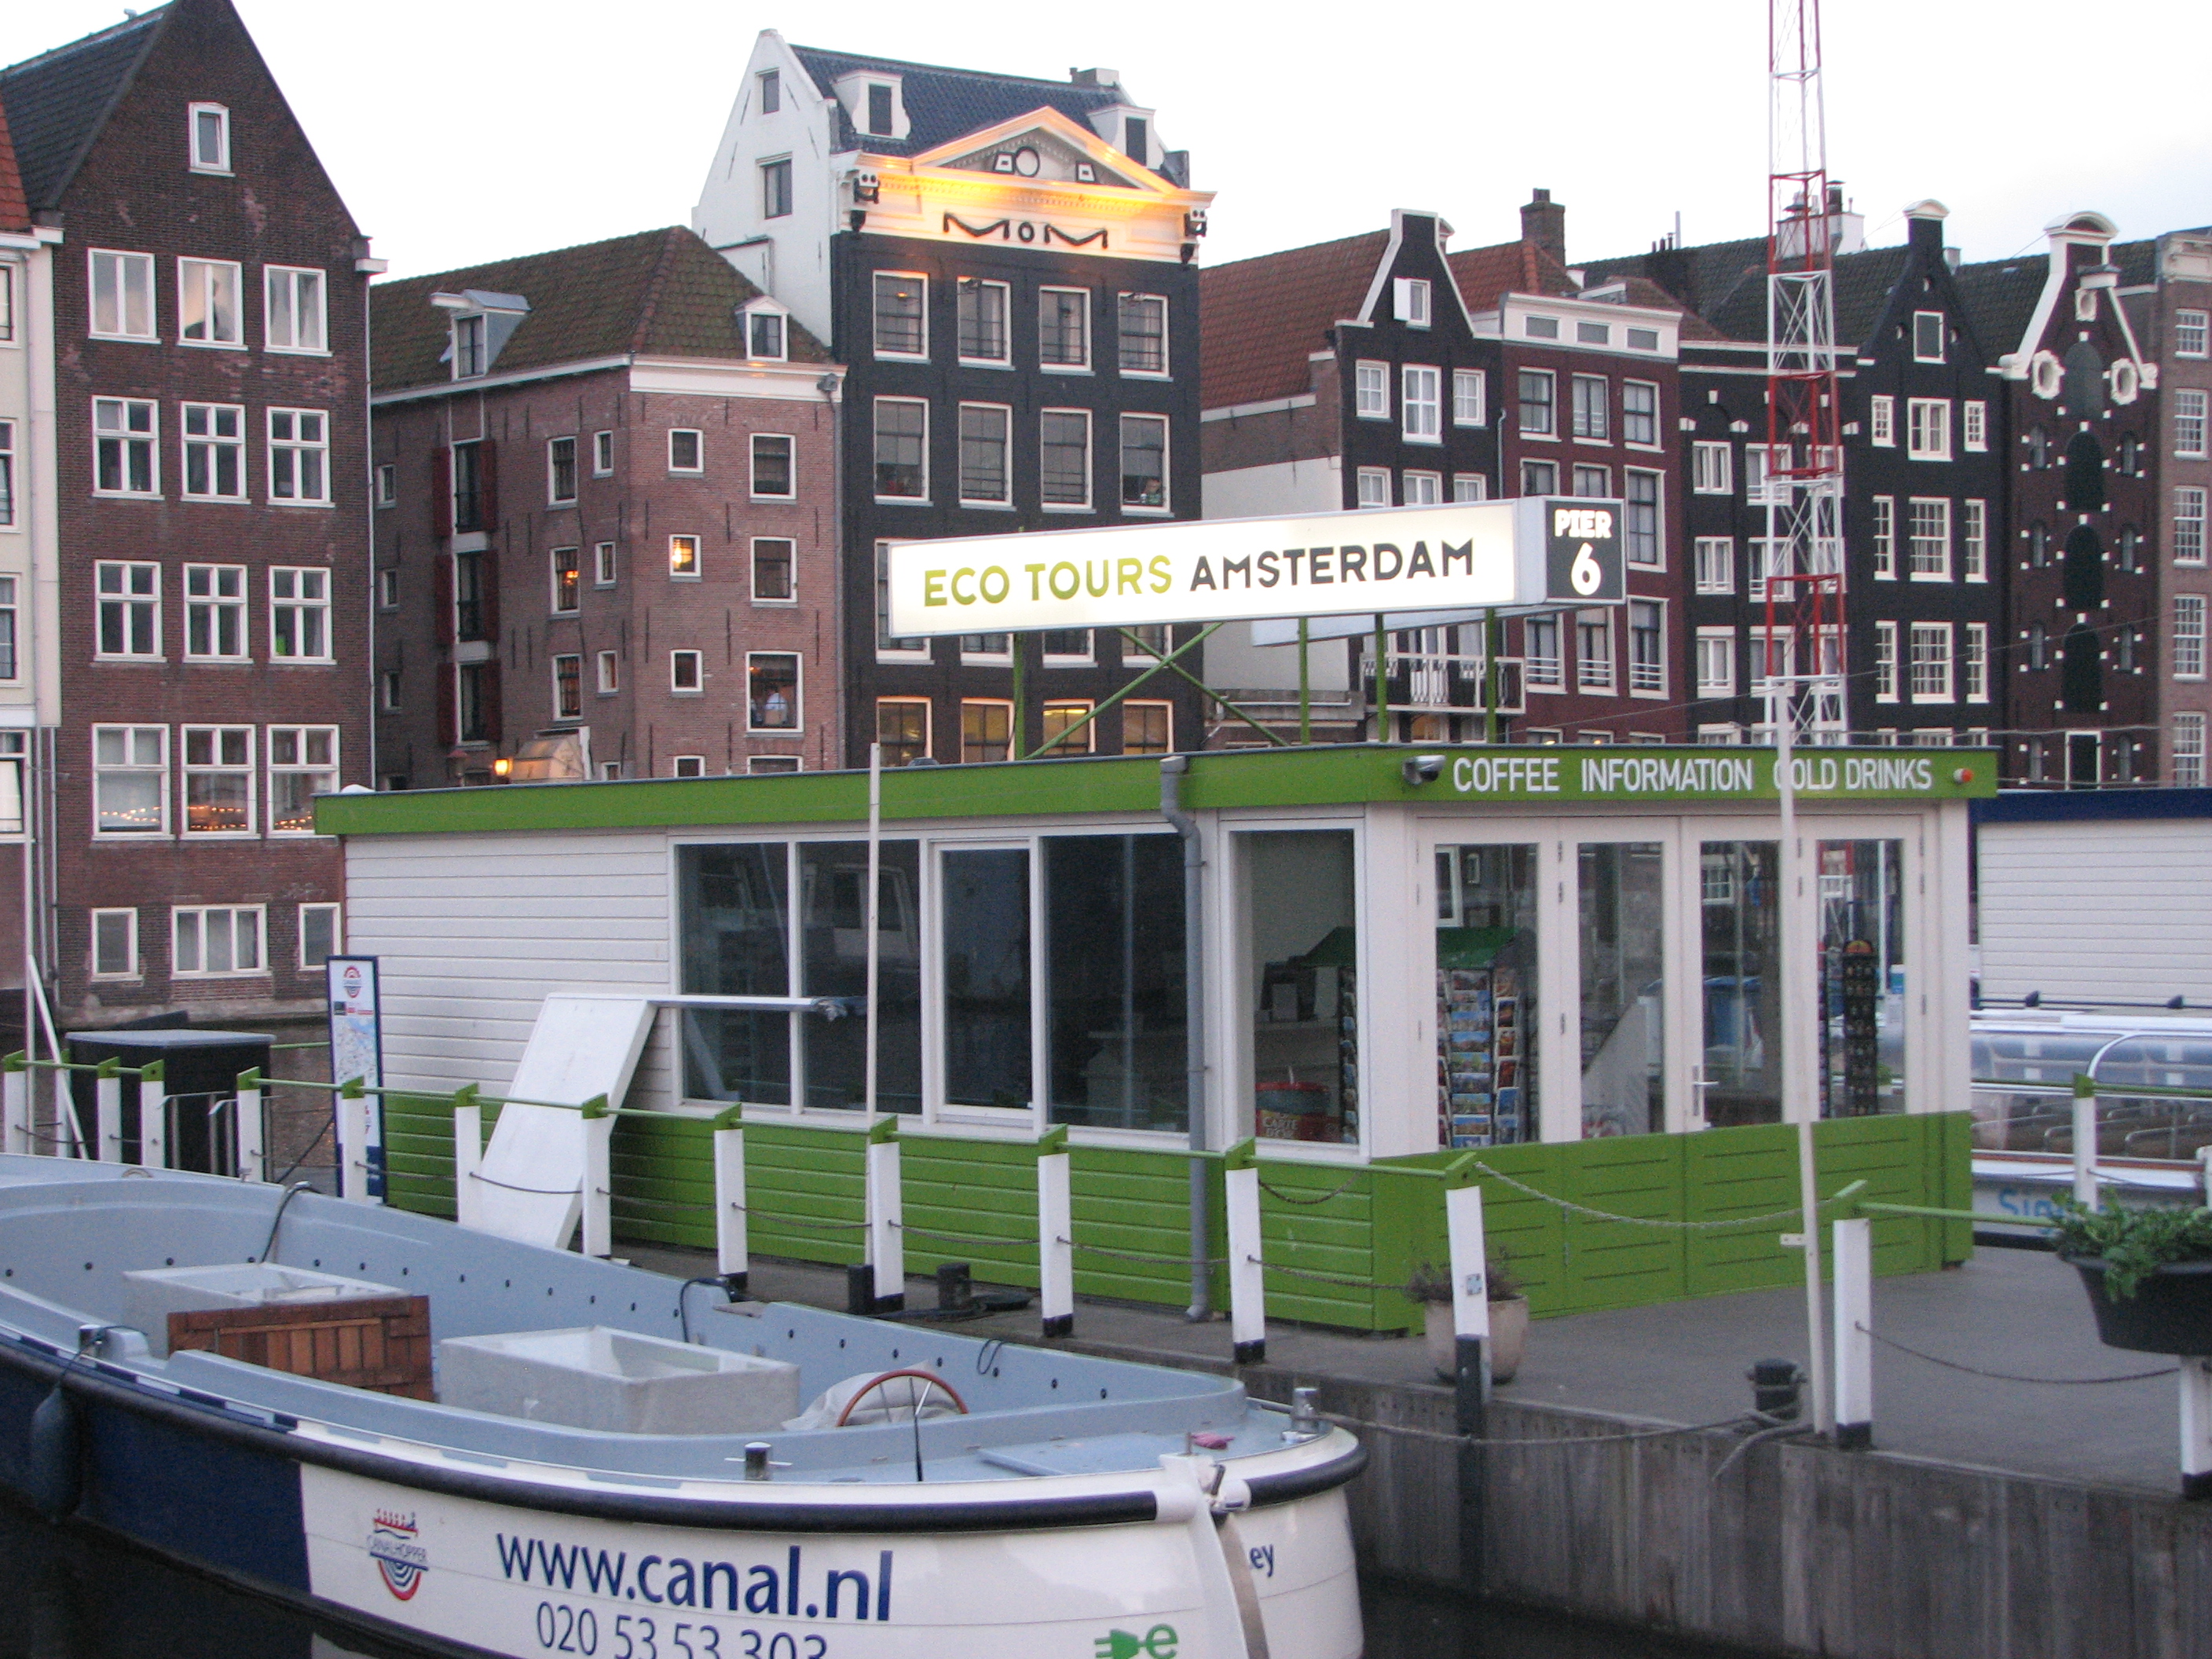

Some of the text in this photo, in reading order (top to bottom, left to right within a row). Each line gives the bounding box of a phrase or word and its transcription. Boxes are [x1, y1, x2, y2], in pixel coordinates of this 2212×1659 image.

[1555, 509, 1612, 538] PIER
[923, 538, 1474, 608] ECO TOURS AMSTERDAM
[1571, 542, 1601, 595] 6
[1453, 757, 1561, 793] COFFEE
[1581, 757, 1753, 793] INFORMATION
[1845, 757, 1932, 791] DRINKS
[496, 1532, 893, 1621] www.canal.nl
[1247, 1544, 1275, 1578] ey
[537, 1600, 599, 1656] 020
[614, 1614, 657, 1659] 53
